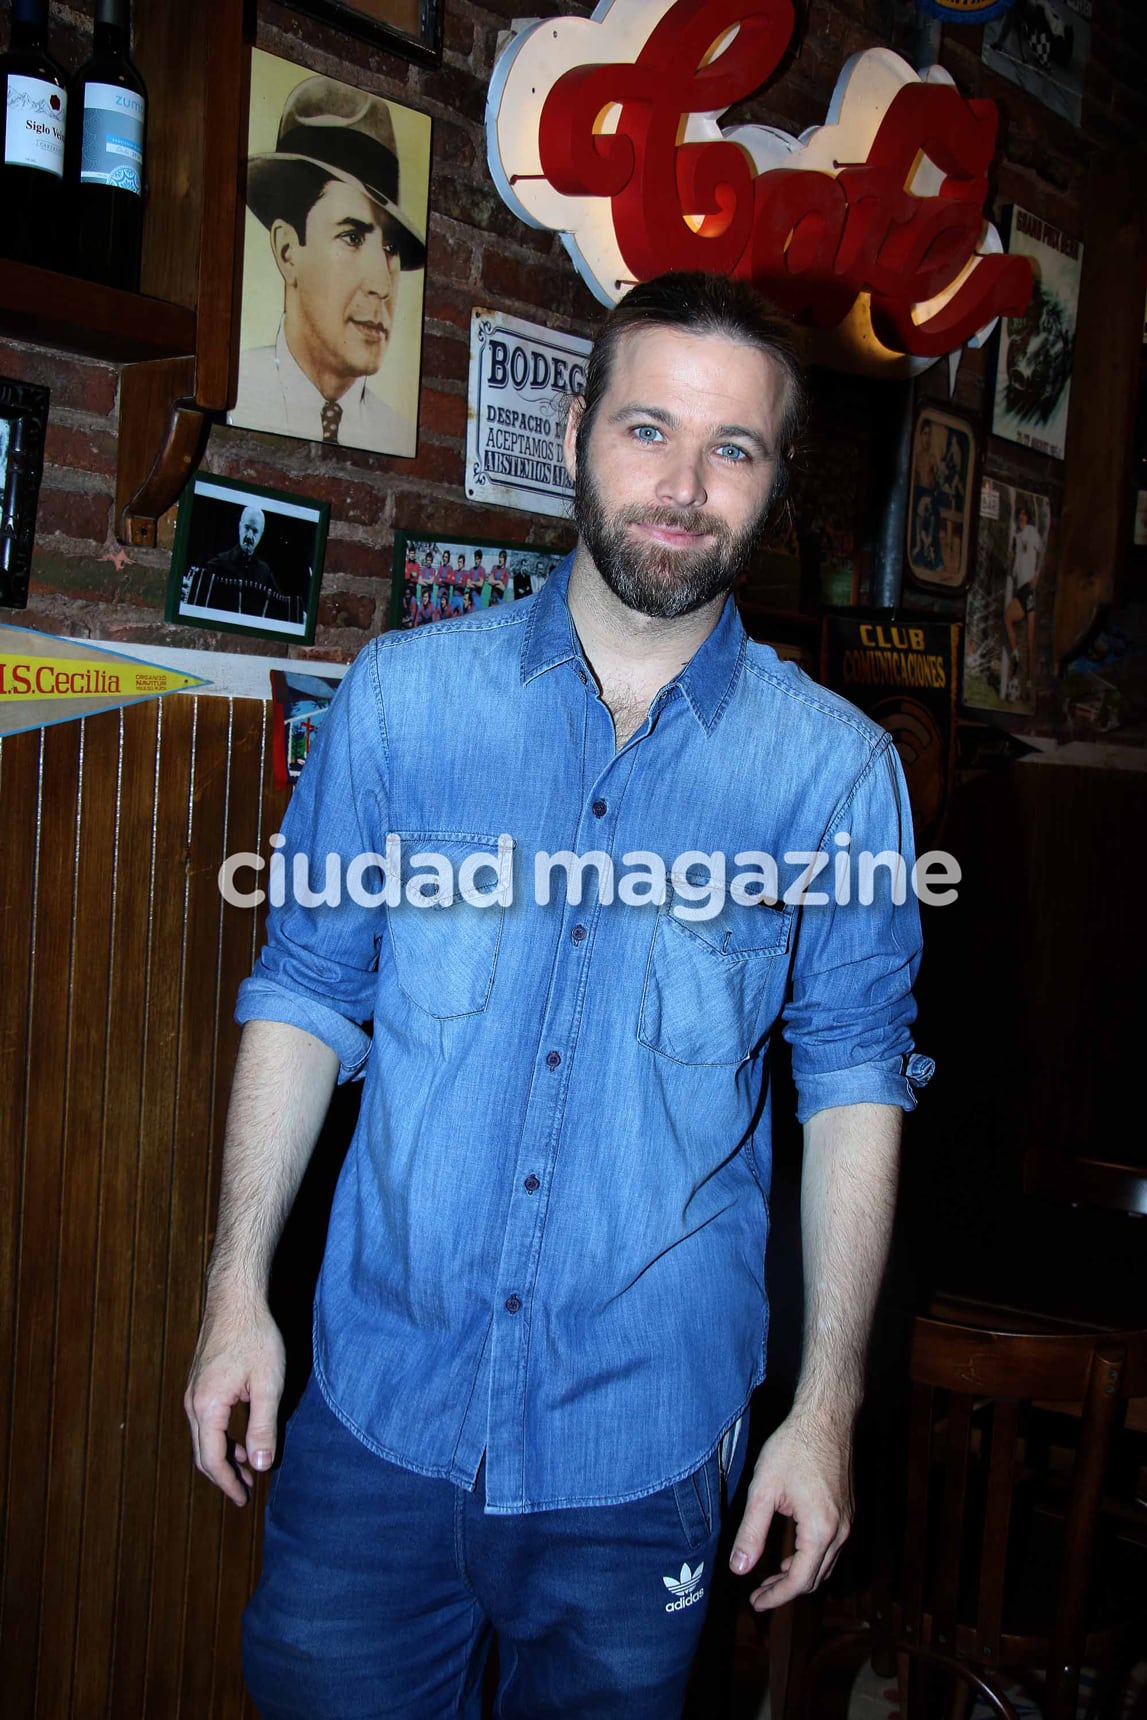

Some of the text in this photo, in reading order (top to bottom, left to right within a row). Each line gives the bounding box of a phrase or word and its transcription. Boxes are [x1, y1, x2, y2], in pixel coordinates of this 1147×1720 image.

[26, 120, 50, 134] Siglo
[487, 405, 551, 436] DESPACHO
[486, 427, 554, 461] ACEPTAMOS
[484, 450, 551, 484] ABSTEMIOS
[860, 624, 926, 651] CLUB
[843, 649, 946, 688] COMUNICACIONES
[665, 1588, 704, 1613] adidas
